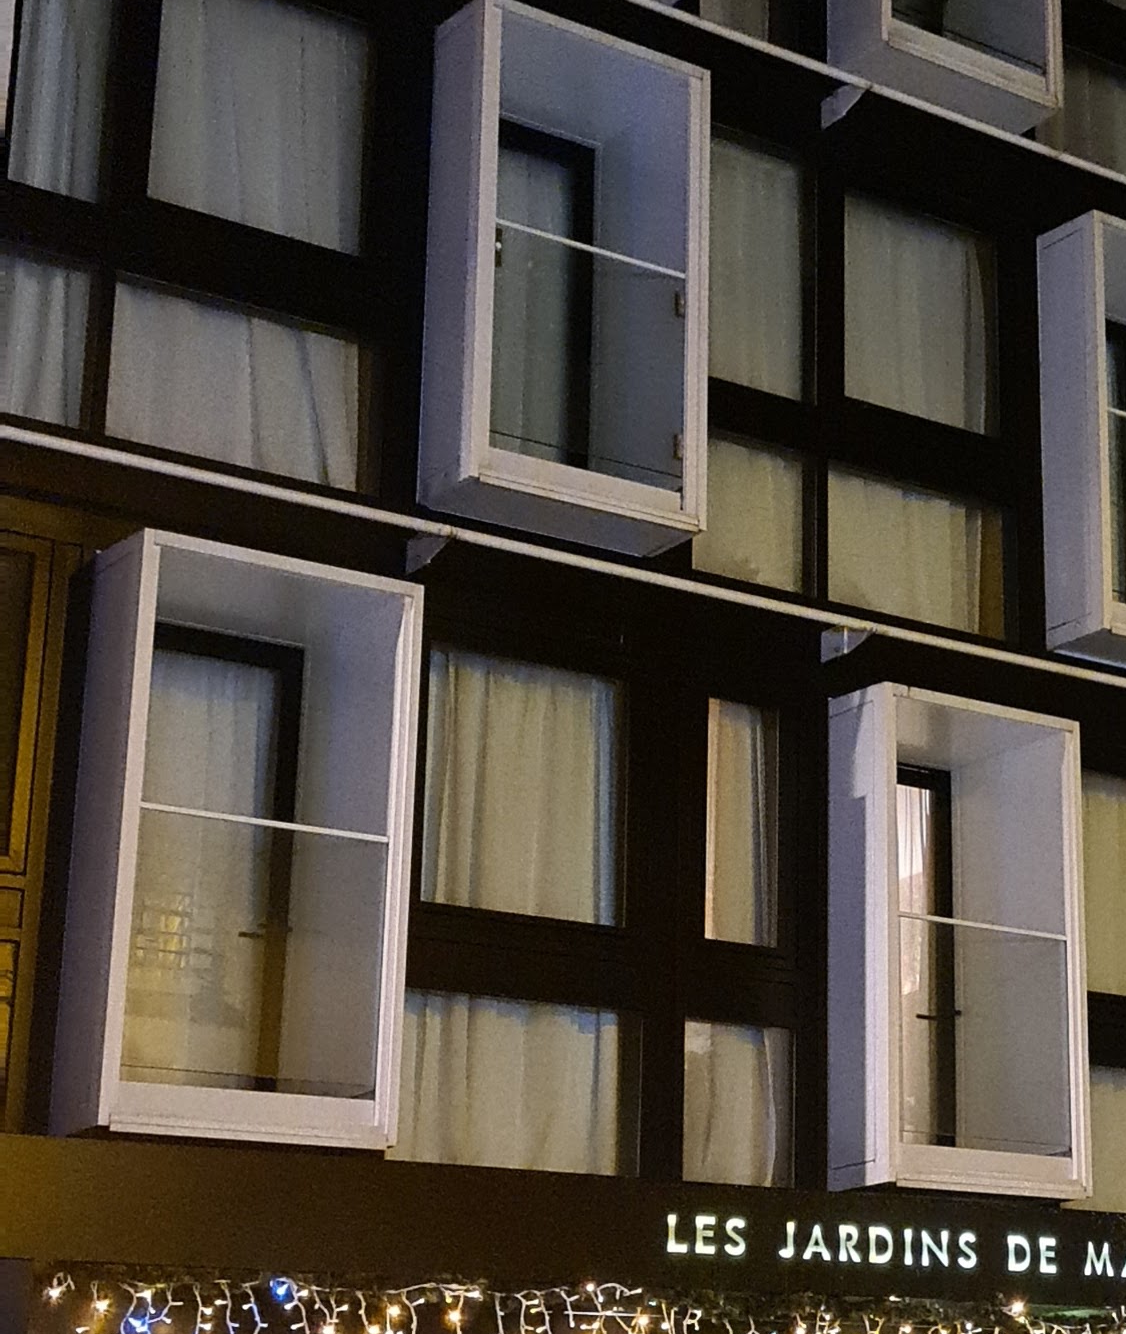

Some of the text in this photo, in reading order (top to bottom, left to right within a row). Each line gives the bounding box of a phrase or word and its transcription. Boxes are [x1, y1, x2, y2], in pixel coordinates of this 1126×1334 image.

[666, 1214, 746, 1256] LES
[778, 1220, 978, 1269] JARDINS
[1006, 1234, 1058, 1275] DE
